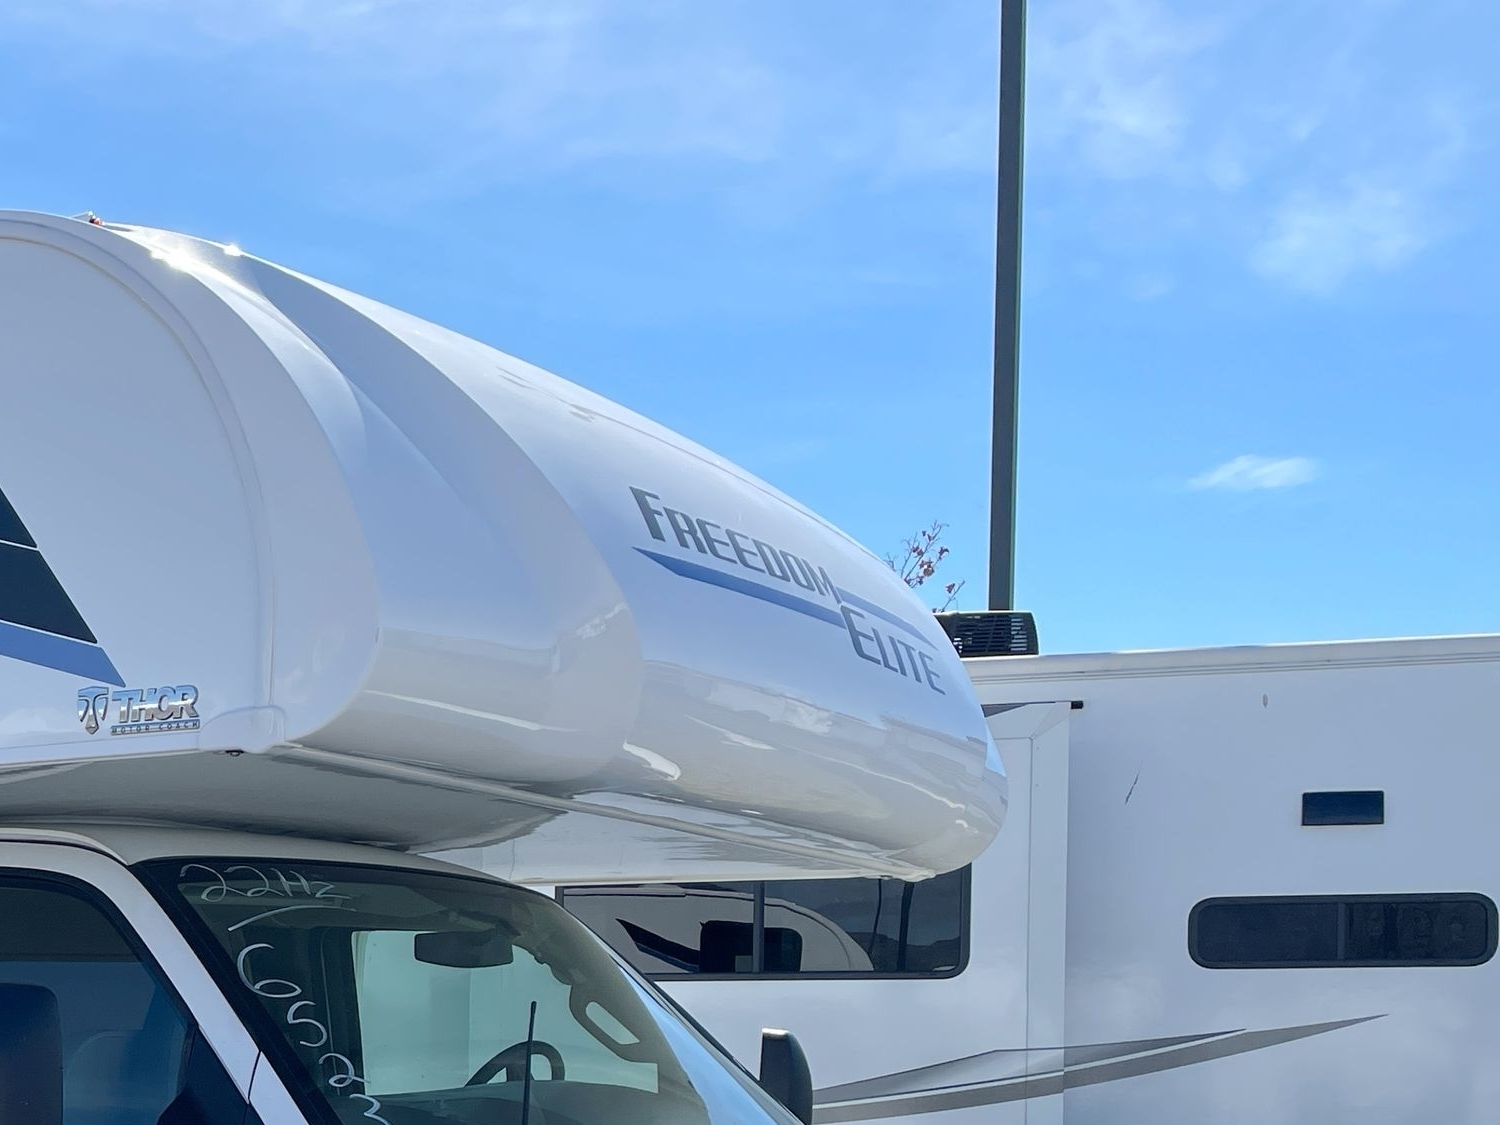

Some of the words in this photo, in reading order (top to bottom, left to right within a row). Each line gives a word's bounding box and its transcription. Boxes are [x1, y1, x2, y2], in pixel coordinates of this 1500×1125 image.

[628, 485, 843, 605] FREEDOM
[839, 604, 947, 696] ELITE
[111, 684, 200, 724] THOR
[158, 720, 199, 731] COACH
